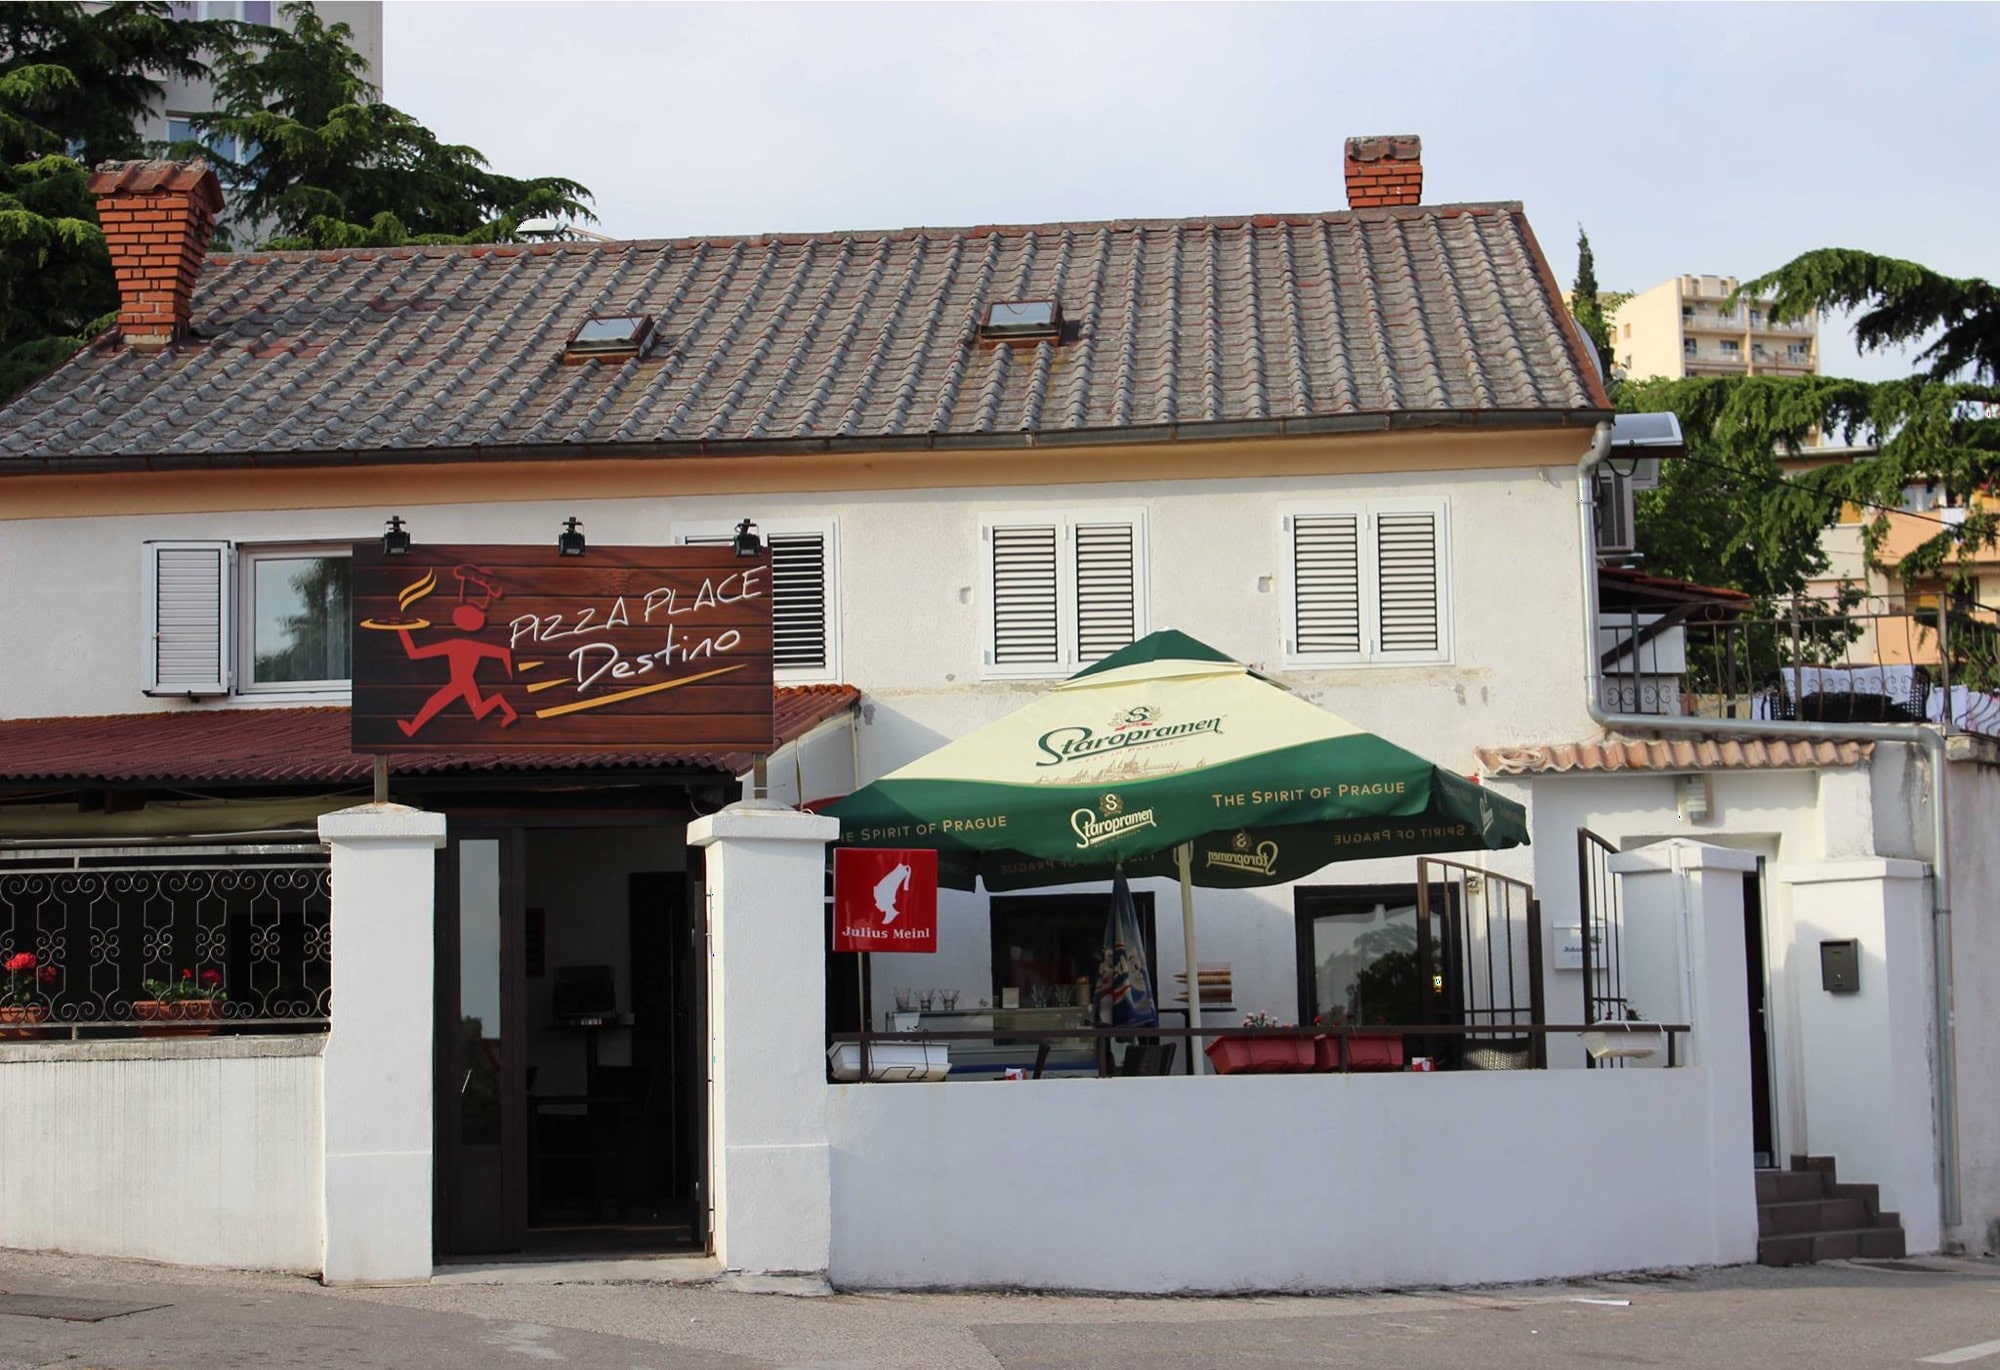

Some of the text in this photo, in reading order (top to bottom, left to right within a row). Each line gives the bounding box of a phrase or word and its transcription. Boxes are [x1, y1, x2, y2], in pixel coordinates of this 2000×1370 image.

[509, 565, 768, 649] PIZZA PLACE
[568, 623, 741, 692] Destino
[1035, 716, 1224, 766] Staropramen
[1105, 793, 1118, 811] S
[1212, 781, 1406, 808] THE SPIRIT OF PRAGUE
[861, 825, 911, 841] SPIRIT
[916, 823, 937, 836] OF
[942, 815, 1008, 833] PRAGUE
[1070, 808, 1157, 848] Staropramen
[842, 926, 930, 939] Julius Meinl
